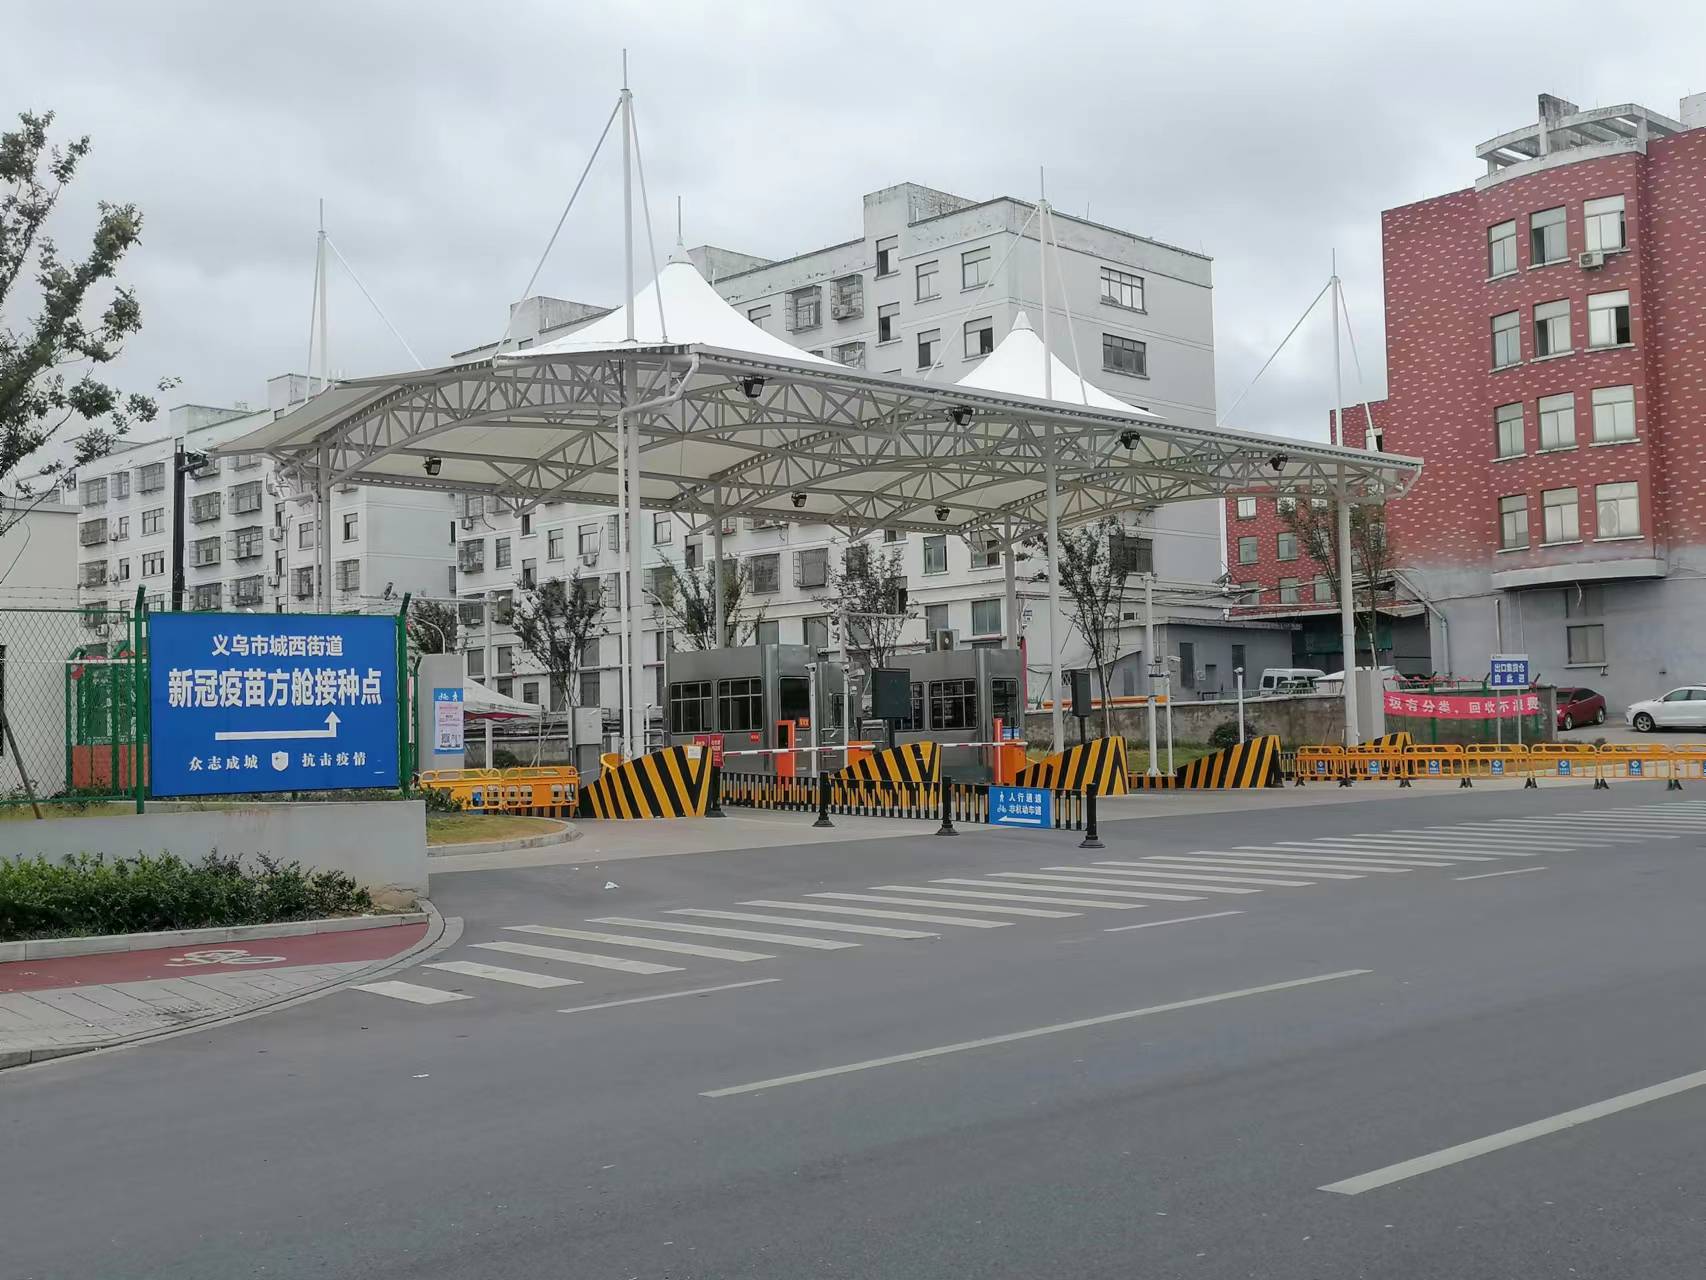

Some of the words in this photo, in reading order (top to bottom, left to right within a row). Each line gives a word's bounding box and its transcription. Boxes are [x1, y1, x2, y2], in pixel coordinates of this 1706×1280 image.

[211, 634, 344, 657] 义乌市城西街道
[168, 667, 383, 709] 新冠疫苗方舱接种点
[189, 754, 259, 772] 众志成城
[301, 751, 367, 768] 抗击疫情
[1009, 792, 1042, 803] 人行通道
[1009, 804, 1042, 816] 非机动车道
